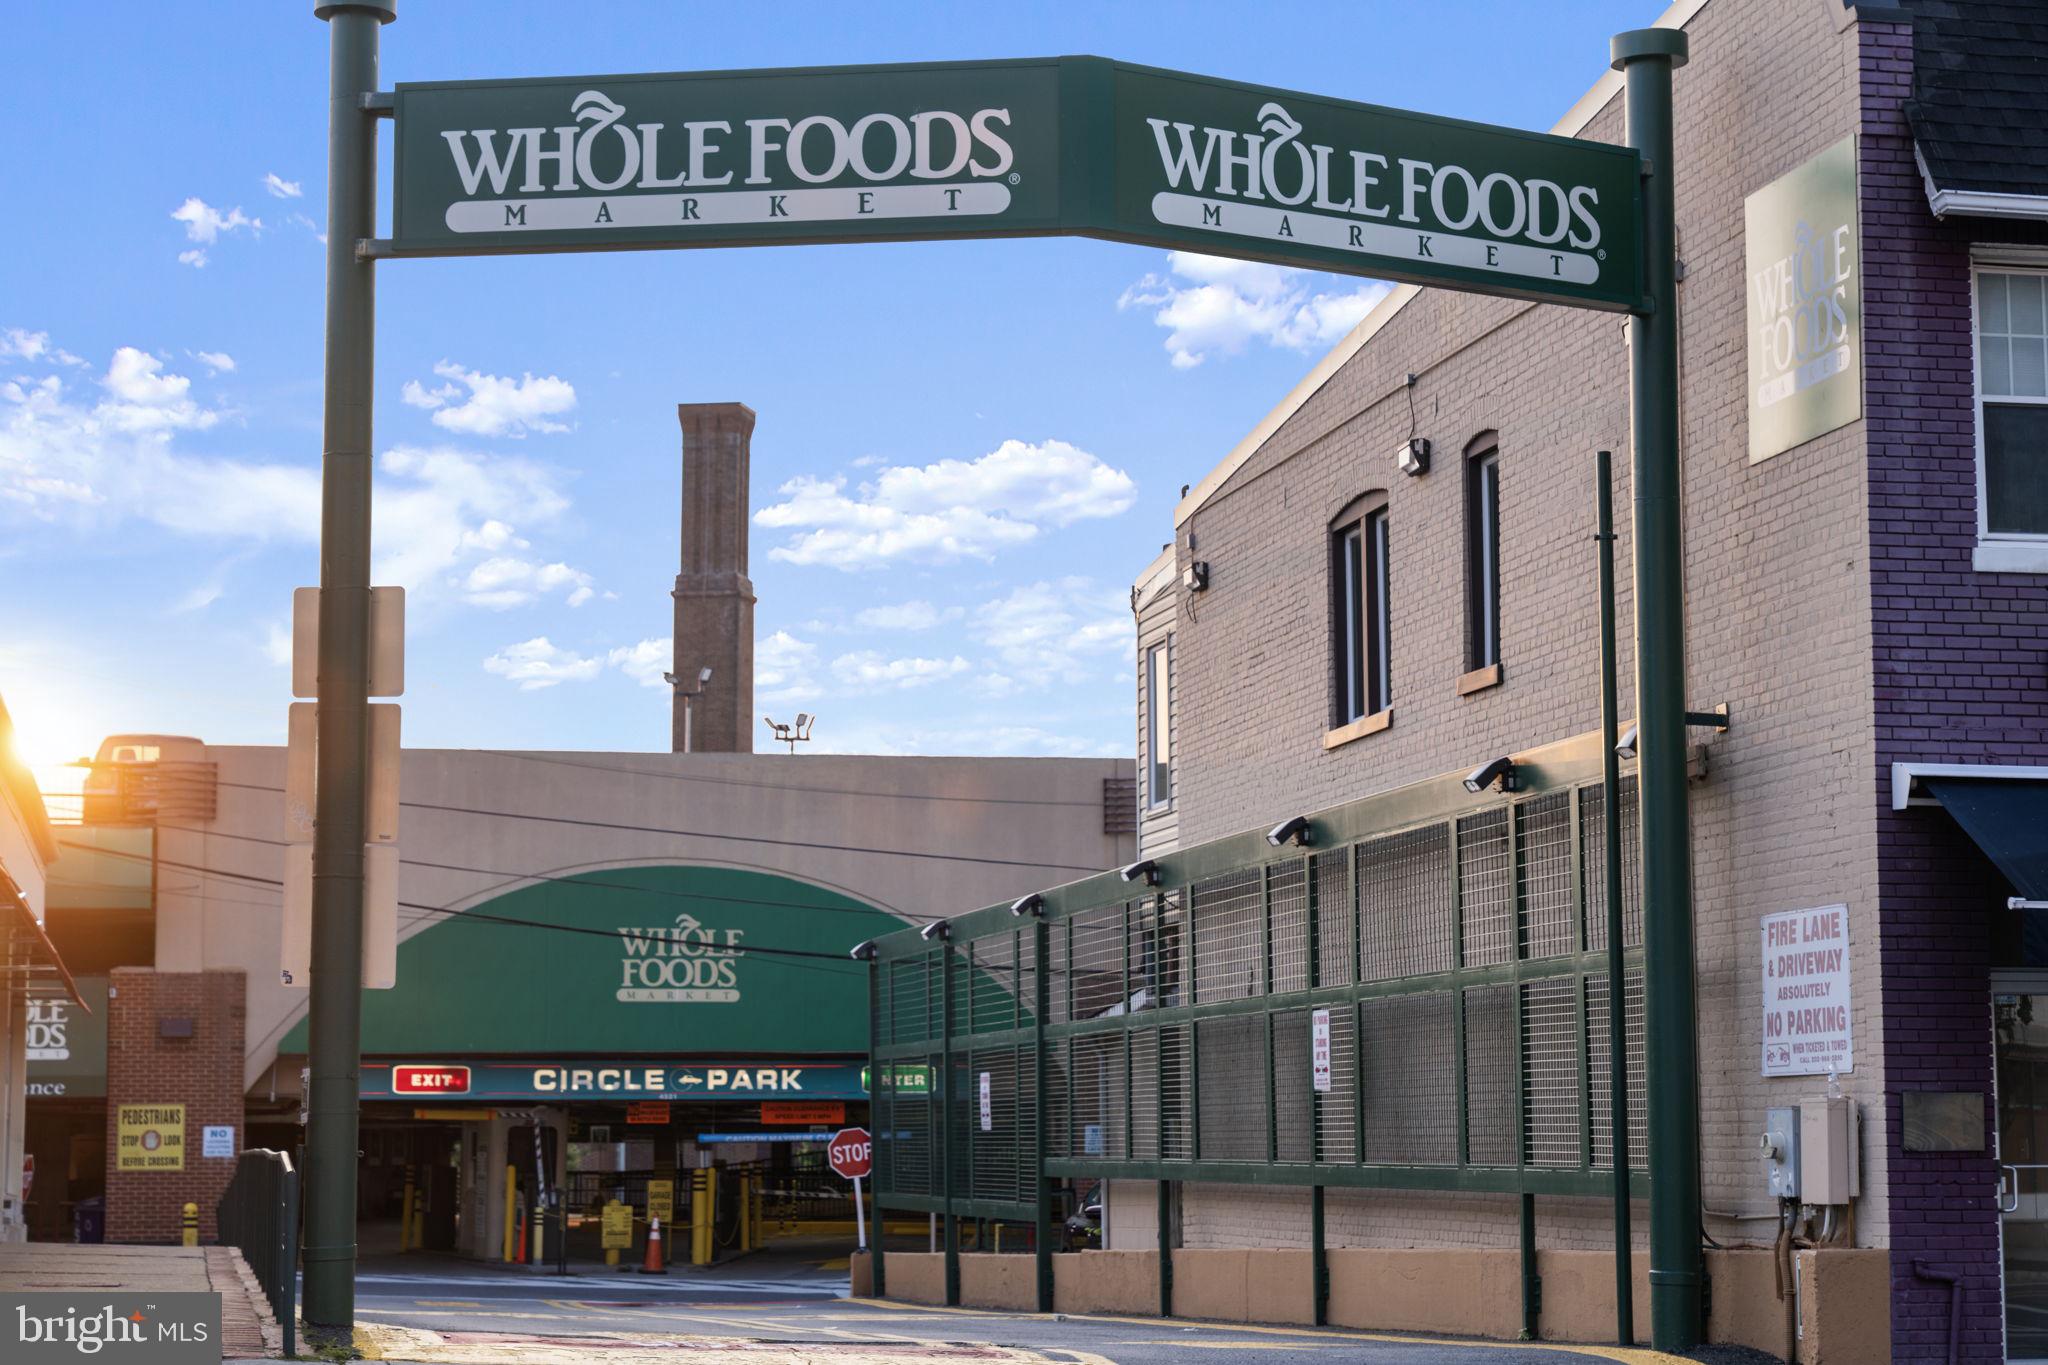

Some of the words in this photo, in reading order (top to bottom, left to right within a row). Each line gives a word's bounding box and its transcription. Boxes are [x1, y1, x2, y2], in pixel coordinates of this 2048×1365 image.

[440, 90, 733, 196] WHOLE
[745, 107, 1014, 186] FOODS
[1146, 102, 1390, 218] WHOLE
[1398, 157, 1601, 250] FOODS
[504, 188, 962, 226] MARKET
[1201, 203, 1565, 276] MARKET
[1754, 222, 1851, 322] WHOLE
[1759, 284, 1848, 380] FOODS
[617, 913, 745, 957] WHOLE
[1768, 918, 1797, 947] FIRE
[1803, 912, 1840, 942] LANE
[621, 958, 737, 987] FOODS
[1768, 960, 1774, 977] &
[1778, 949, 1843, 978] DRIVEWAY
[626, 991, 731, 1000] MARKET
[1777, 982, 1831, 1001] ABSOLUTELY
[1766, 1012, 1782, 1037] NO
[1787, 1005, 1846, 1036] PARKING
[411, 1074, 452, 1086] EXIT
[533, 1069, 665, 1090] CIRCLE
[707, 1069, 803, 1090] PARK
[882, 1074, 926, 1086] NTER
[122, 1109, 181, 1125] PEDESTRIANS
[121, 1135, 139, 1147] STOP
[164, 1135, 181, 1146] LOOK
[211, 1130, 227, 1138] NO
[123, 1157, 145, 1166] BEFORE
[148, 1156, 179, 1167] CROSSING
